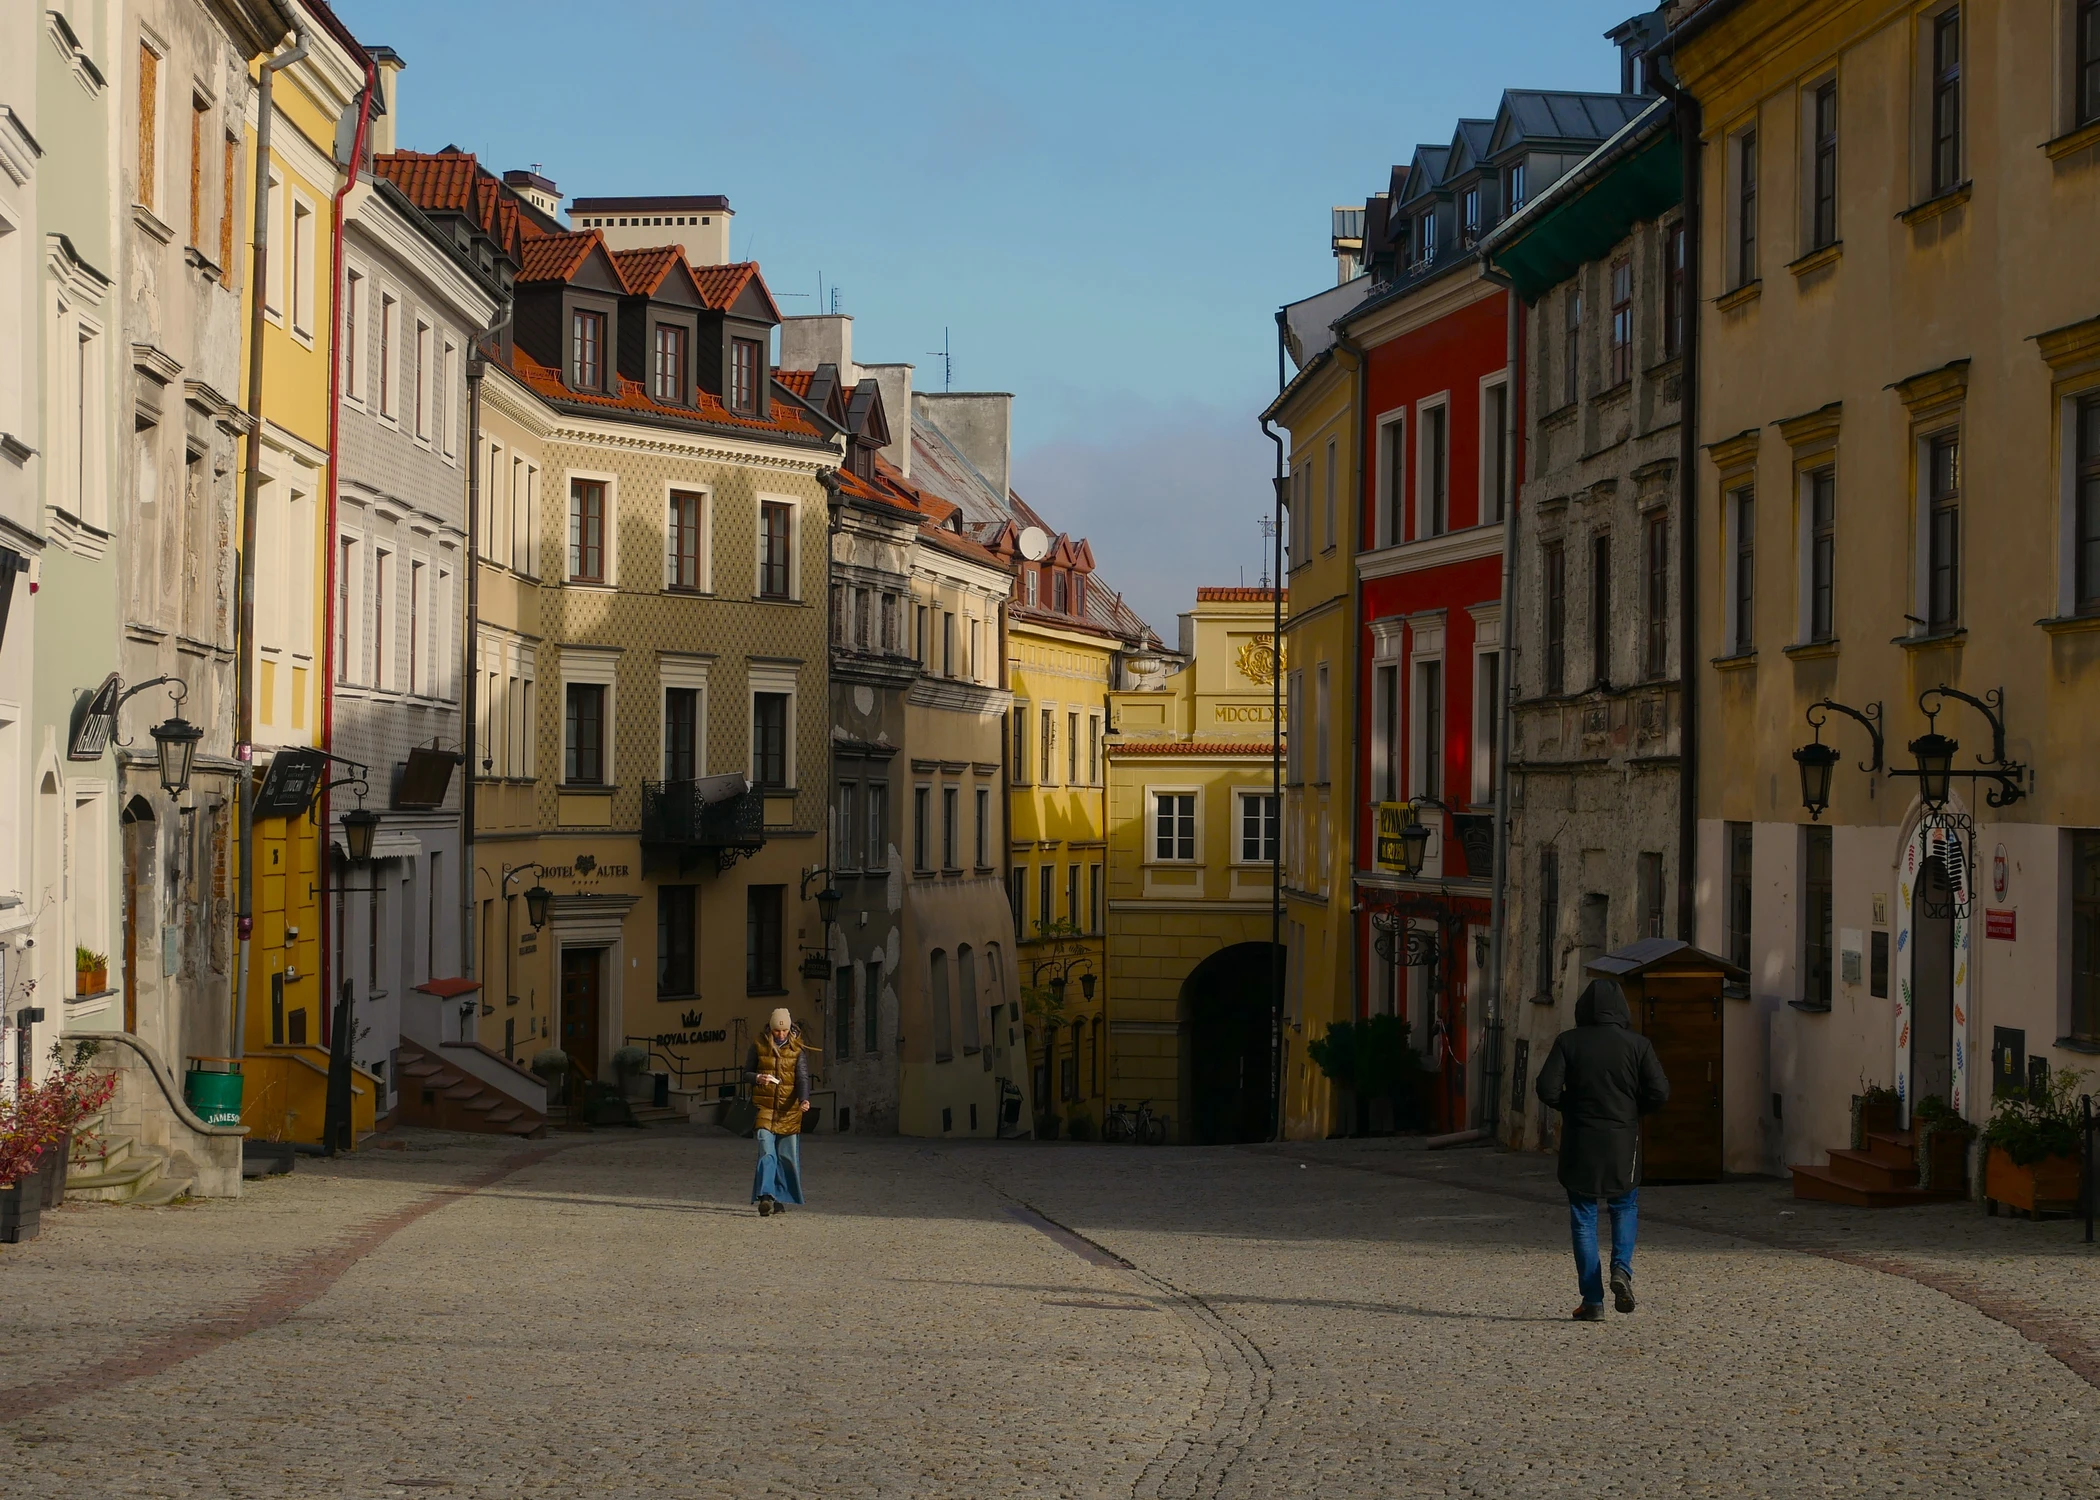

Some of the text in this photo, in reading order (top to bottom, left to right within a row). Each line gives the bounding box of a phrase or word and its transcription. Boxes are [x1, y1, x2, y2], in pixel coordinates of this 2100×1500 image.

[1927, 814, 1970, 829] MDK
[541, 865, 629, 878] HOTEL ALTER
[656, 1029, 726, 1046] ROYAL CASINO
